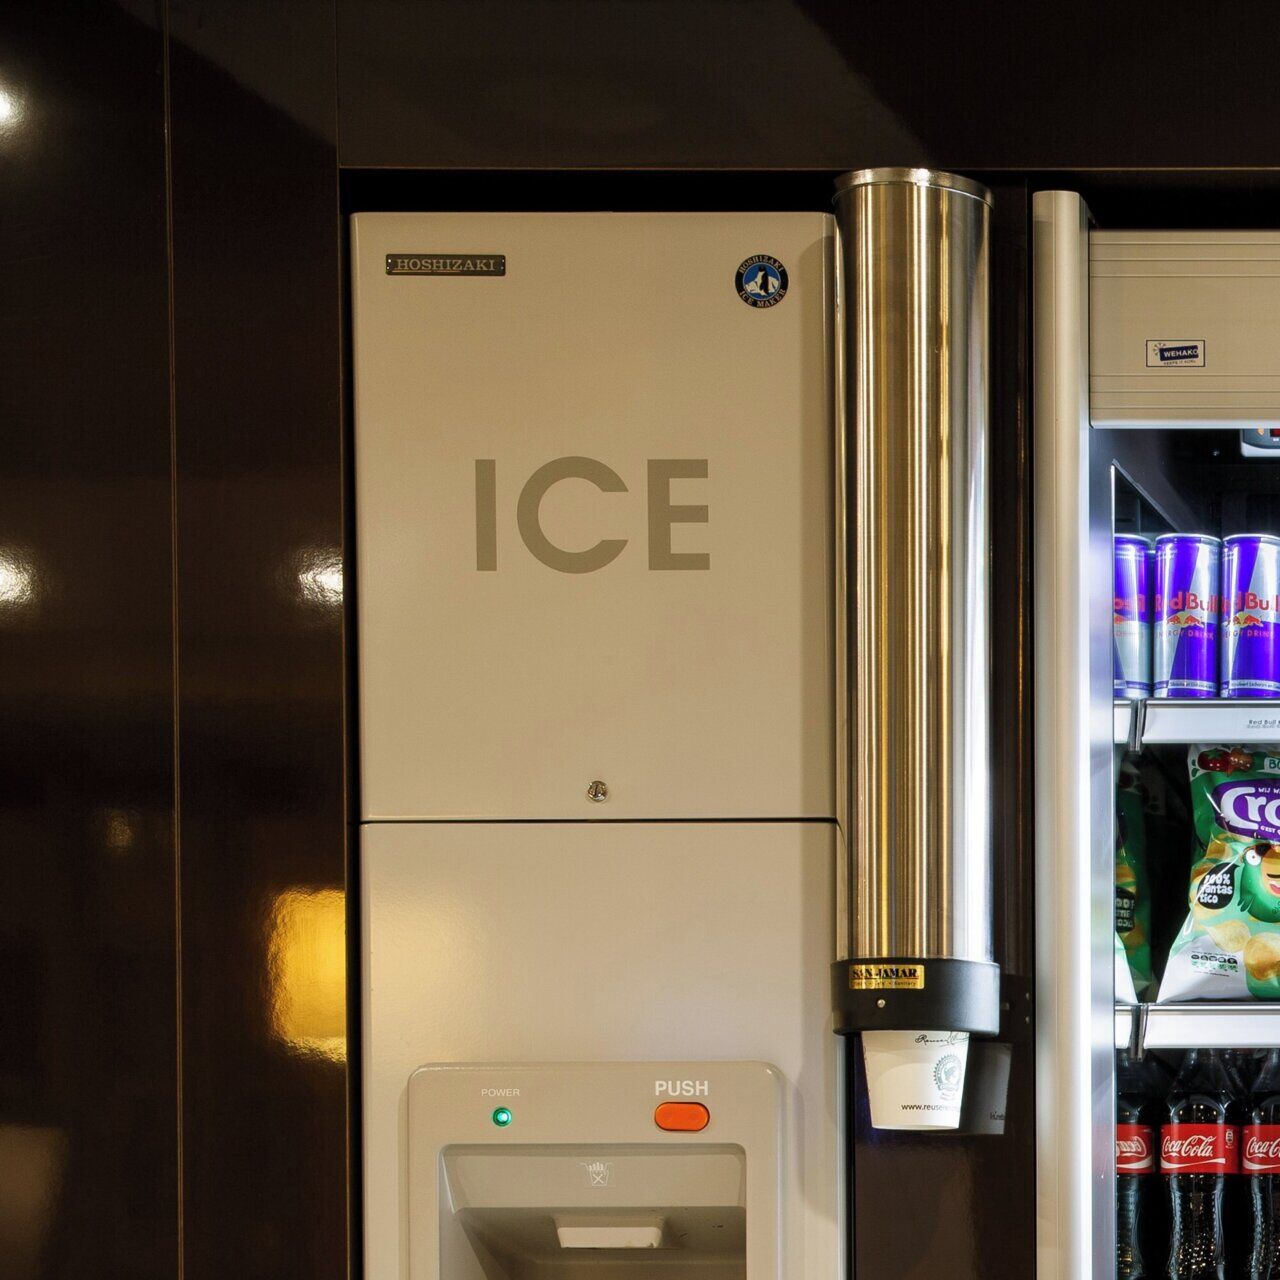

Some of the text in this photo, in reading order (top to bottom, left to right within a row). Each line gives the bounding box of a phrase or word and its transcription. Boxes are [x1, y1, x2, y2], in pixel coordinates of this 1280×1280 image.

[396, 258, 496, 271] HOSHIZAKI
[1163, 348, 1198, 358] WEHAKO
[475, 456, 710, 574] ICE
[1187, 630, 1214, 641] DRINK
[876, 968, 918, 978] JAMAR
[481, 1088, 520, 1097] POWER
[654, 1080, 709, 1096] PUSH
[1162, 1135, 1217, 1157] Coca-Cola
